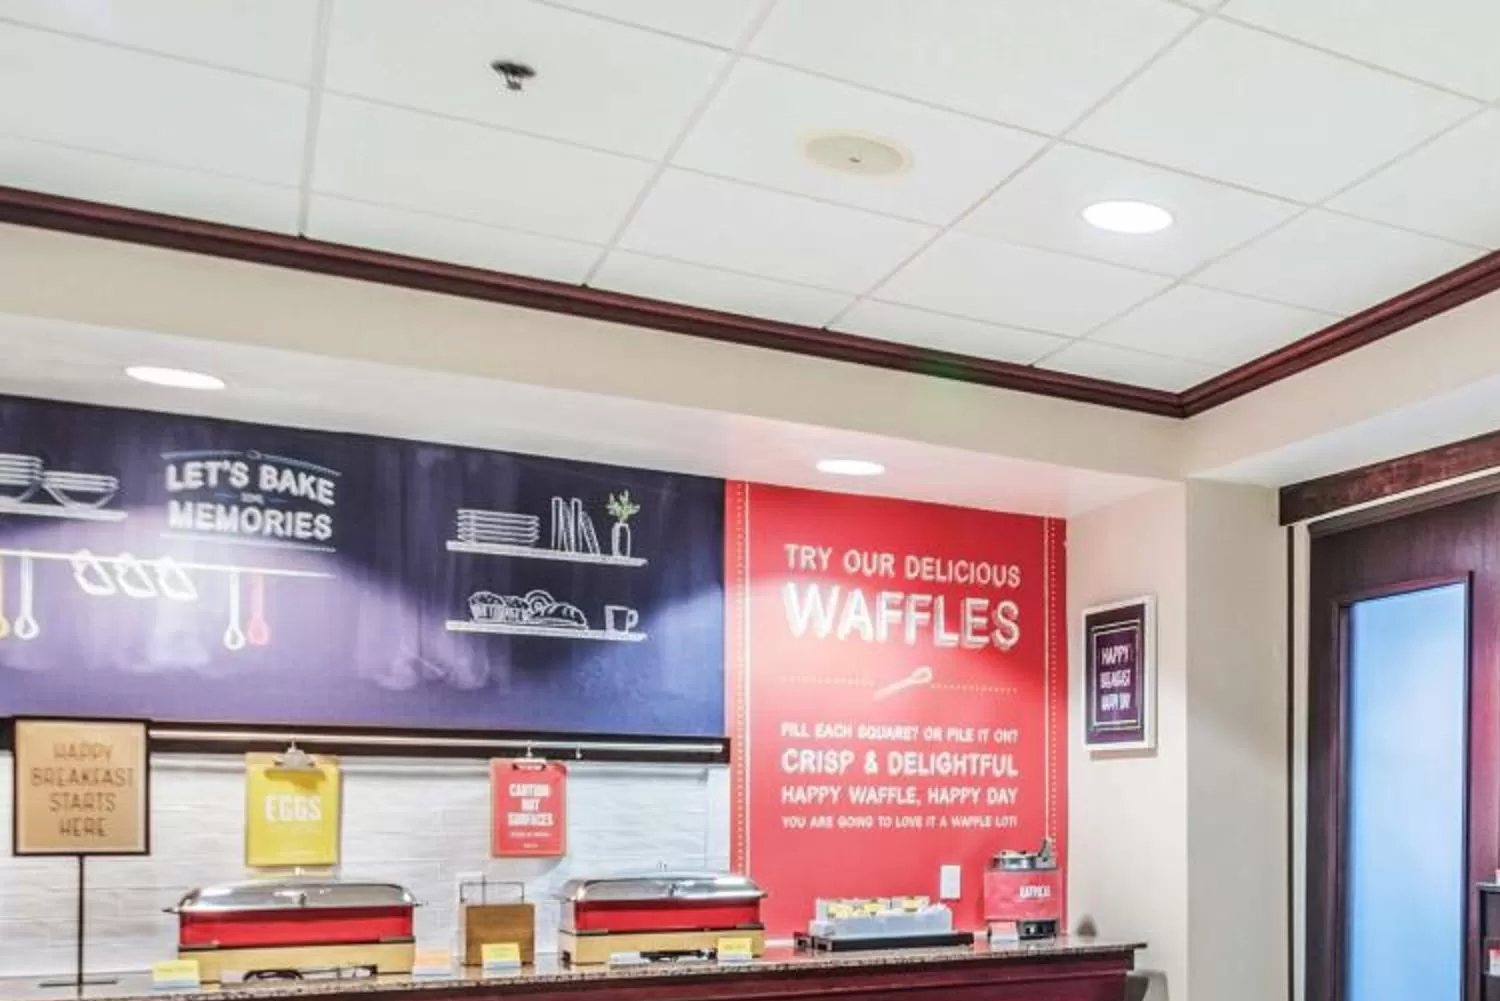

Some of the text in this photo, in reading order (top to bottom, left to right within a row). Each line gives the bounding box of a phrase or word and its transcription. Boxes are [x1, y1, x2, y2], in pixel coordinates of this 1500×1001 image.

[166, 460, 335, 506] LET'S BAKE
[168, 500, 332, 540] MEMORIES
[784, 543, 1021, 588] TRY OUR DELICIOUS
[784, 582, 1020, 652] WAFFLES
[780, 722, 1018, 744] FILL EACH SQUARE? OR PILE IT ON?
[53, 742, 111, 761] HAPPY
[781, 747, 1019, 778] CRISP & DELIGHTFUL
[31, 766, 134, 787] BREAKFAST
[48, 791, 116, 813] STARTS
[781, 785, 1019, 807] HAPPY WAFFLE, HAPPY DAY
[265, 794, 321, 821] EGGS
[59, 817, 107, 837] HERE
[782, 815, 804, 829] YOU
[809, 815, 833, 829] ARE
[837, 815, 873, 829] GOING
[878, 815, 892, 829] TO
[895, 815, 922, 829] LOVE
[925, 815, 935, 828] IT
[938, 815, 948, 828] A
[951, 815, 992, 829] WAFFLE
